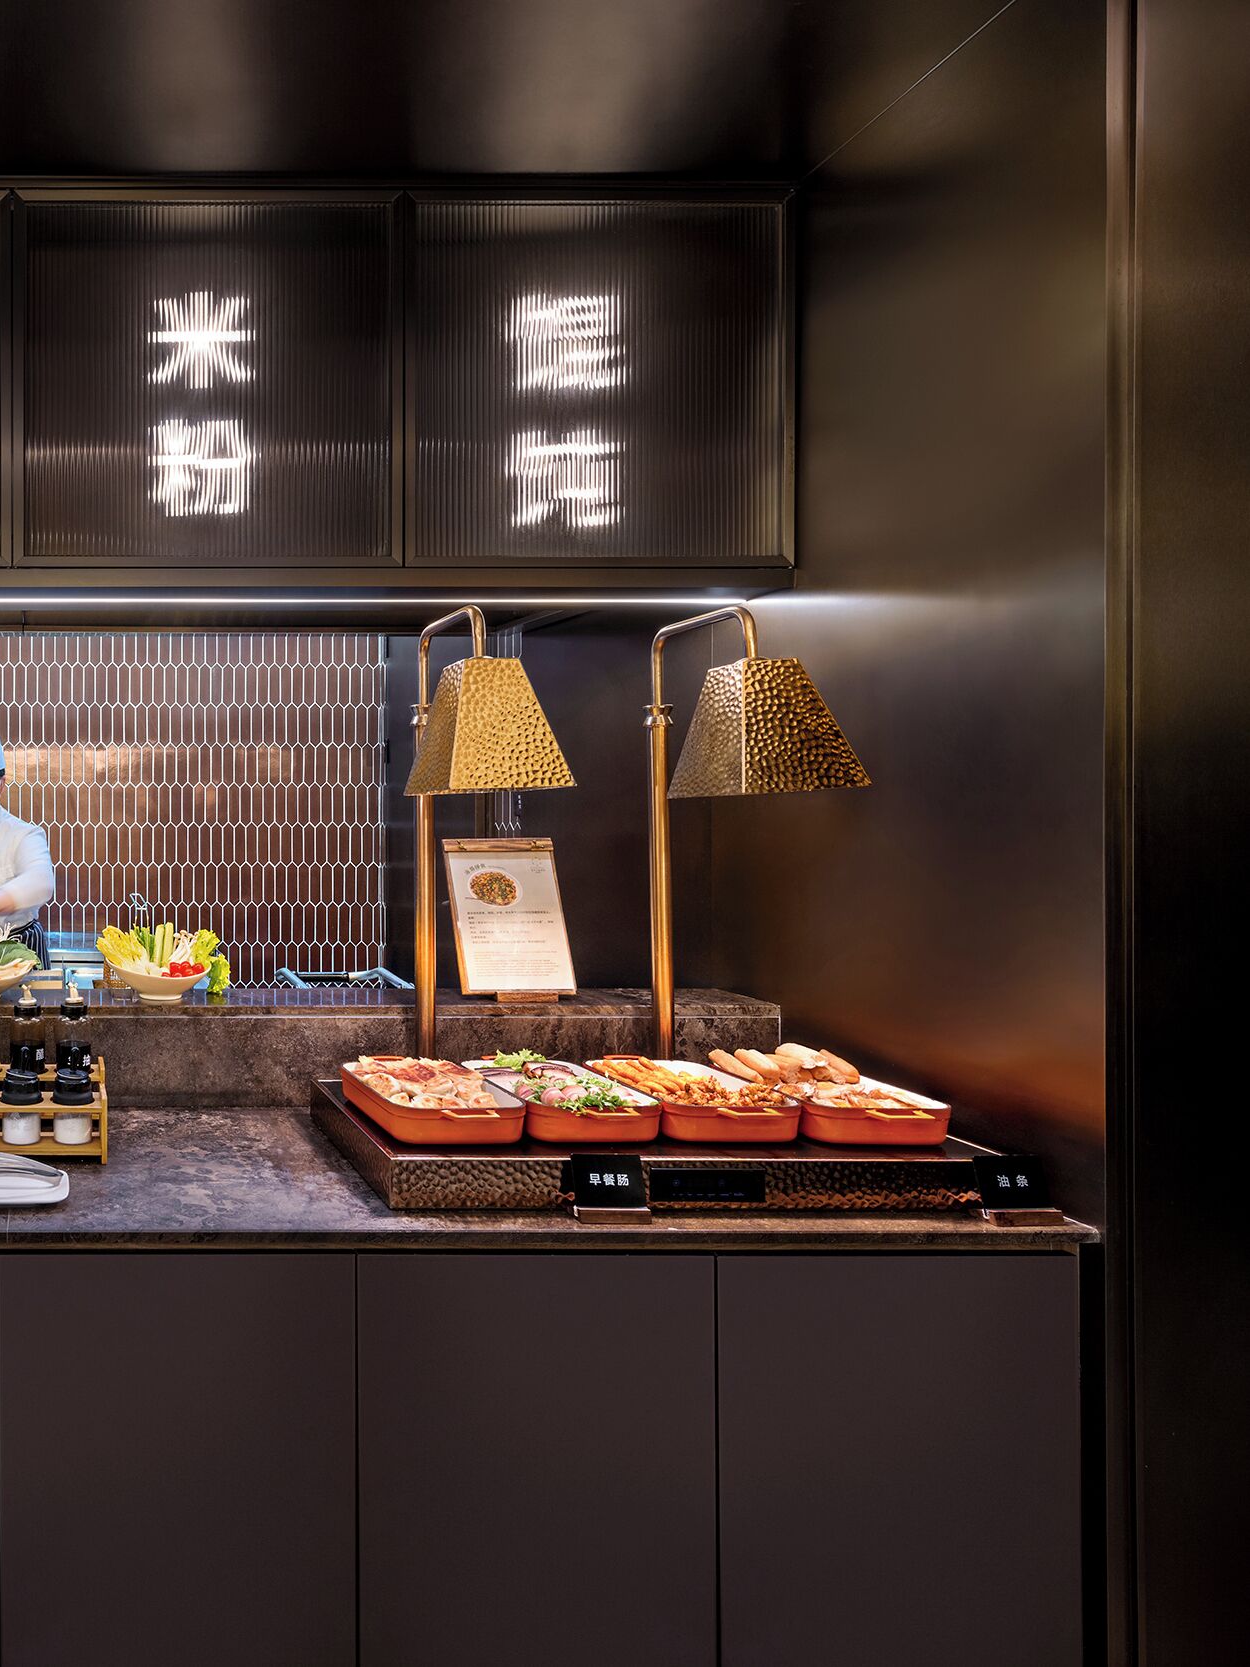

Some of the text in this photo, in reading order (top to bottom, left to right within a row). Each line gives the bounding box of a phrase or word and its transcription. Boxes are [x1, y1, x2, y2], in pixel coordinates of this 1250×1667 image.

[147, 291, 260, 517] 米粉
[505, 293, 630, 527] 馄饨
[589, 1173, 630, 1187] 早餐肠
[996, 1174, 1029, 1188] 油条
